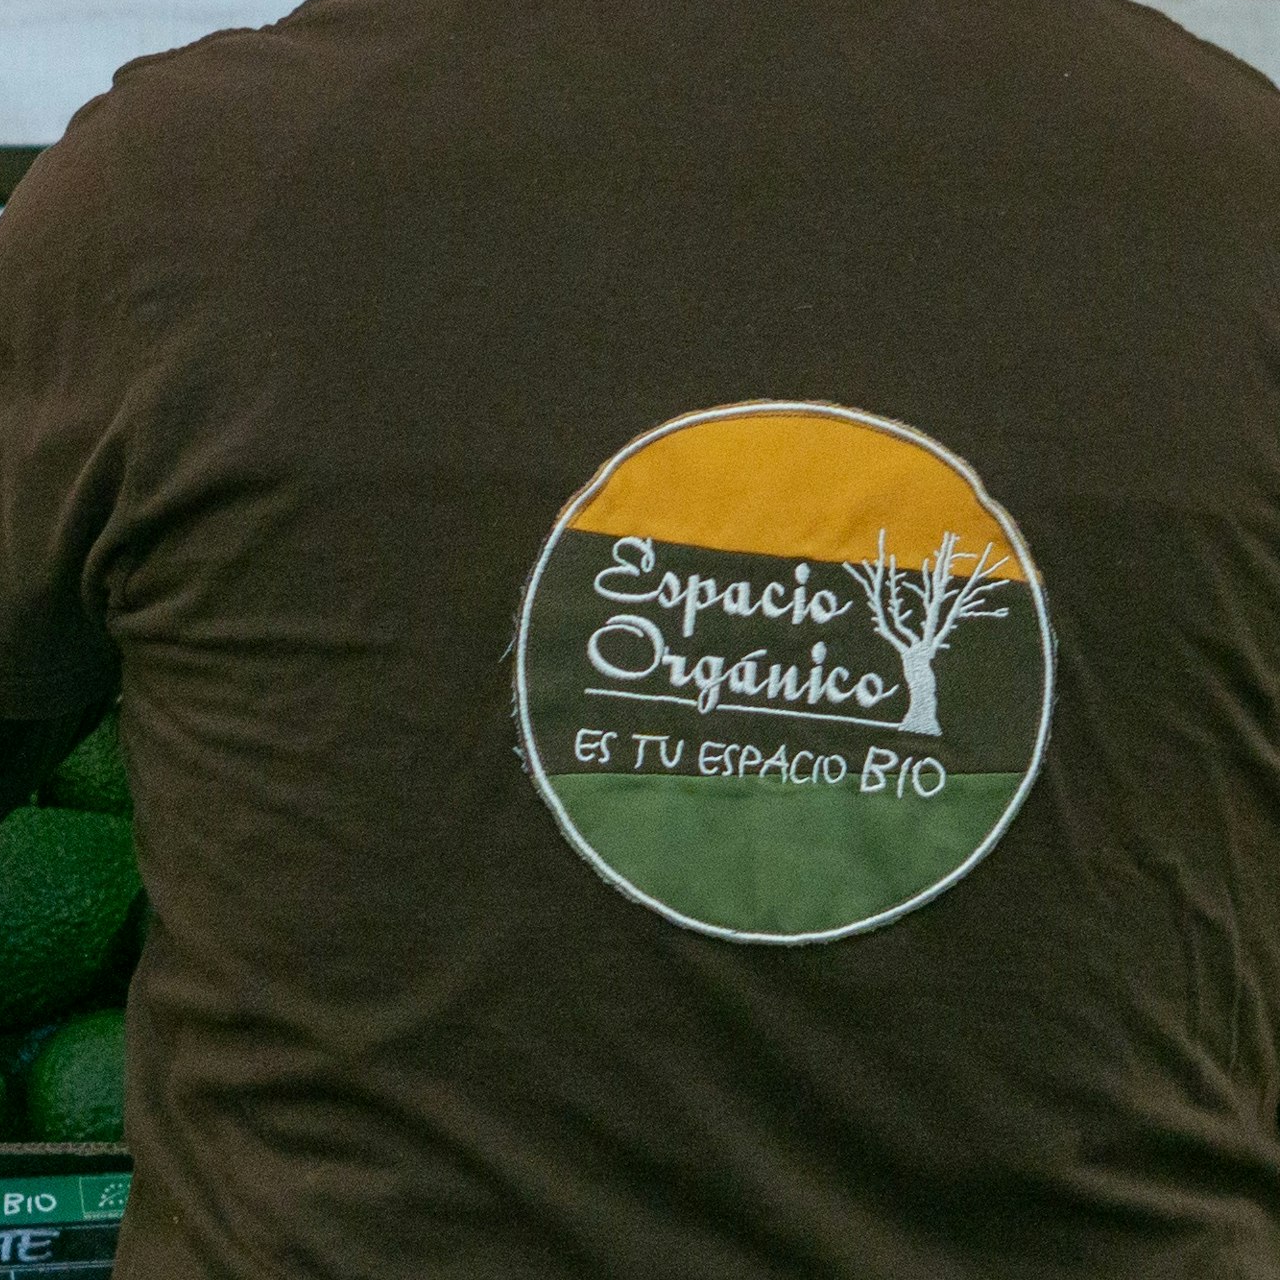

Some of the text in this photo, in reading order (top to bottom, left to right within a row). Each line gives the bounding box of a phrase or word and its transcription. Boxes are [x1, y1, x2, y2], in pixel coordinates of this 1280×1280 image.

[594, 536, 853, 637] Espacio
[587, 614, 899, 714] Orgánico
[575, 729, 946, 798] ES TU ESPACIO BIO
[3, 1191, 57, 1217] BIO
